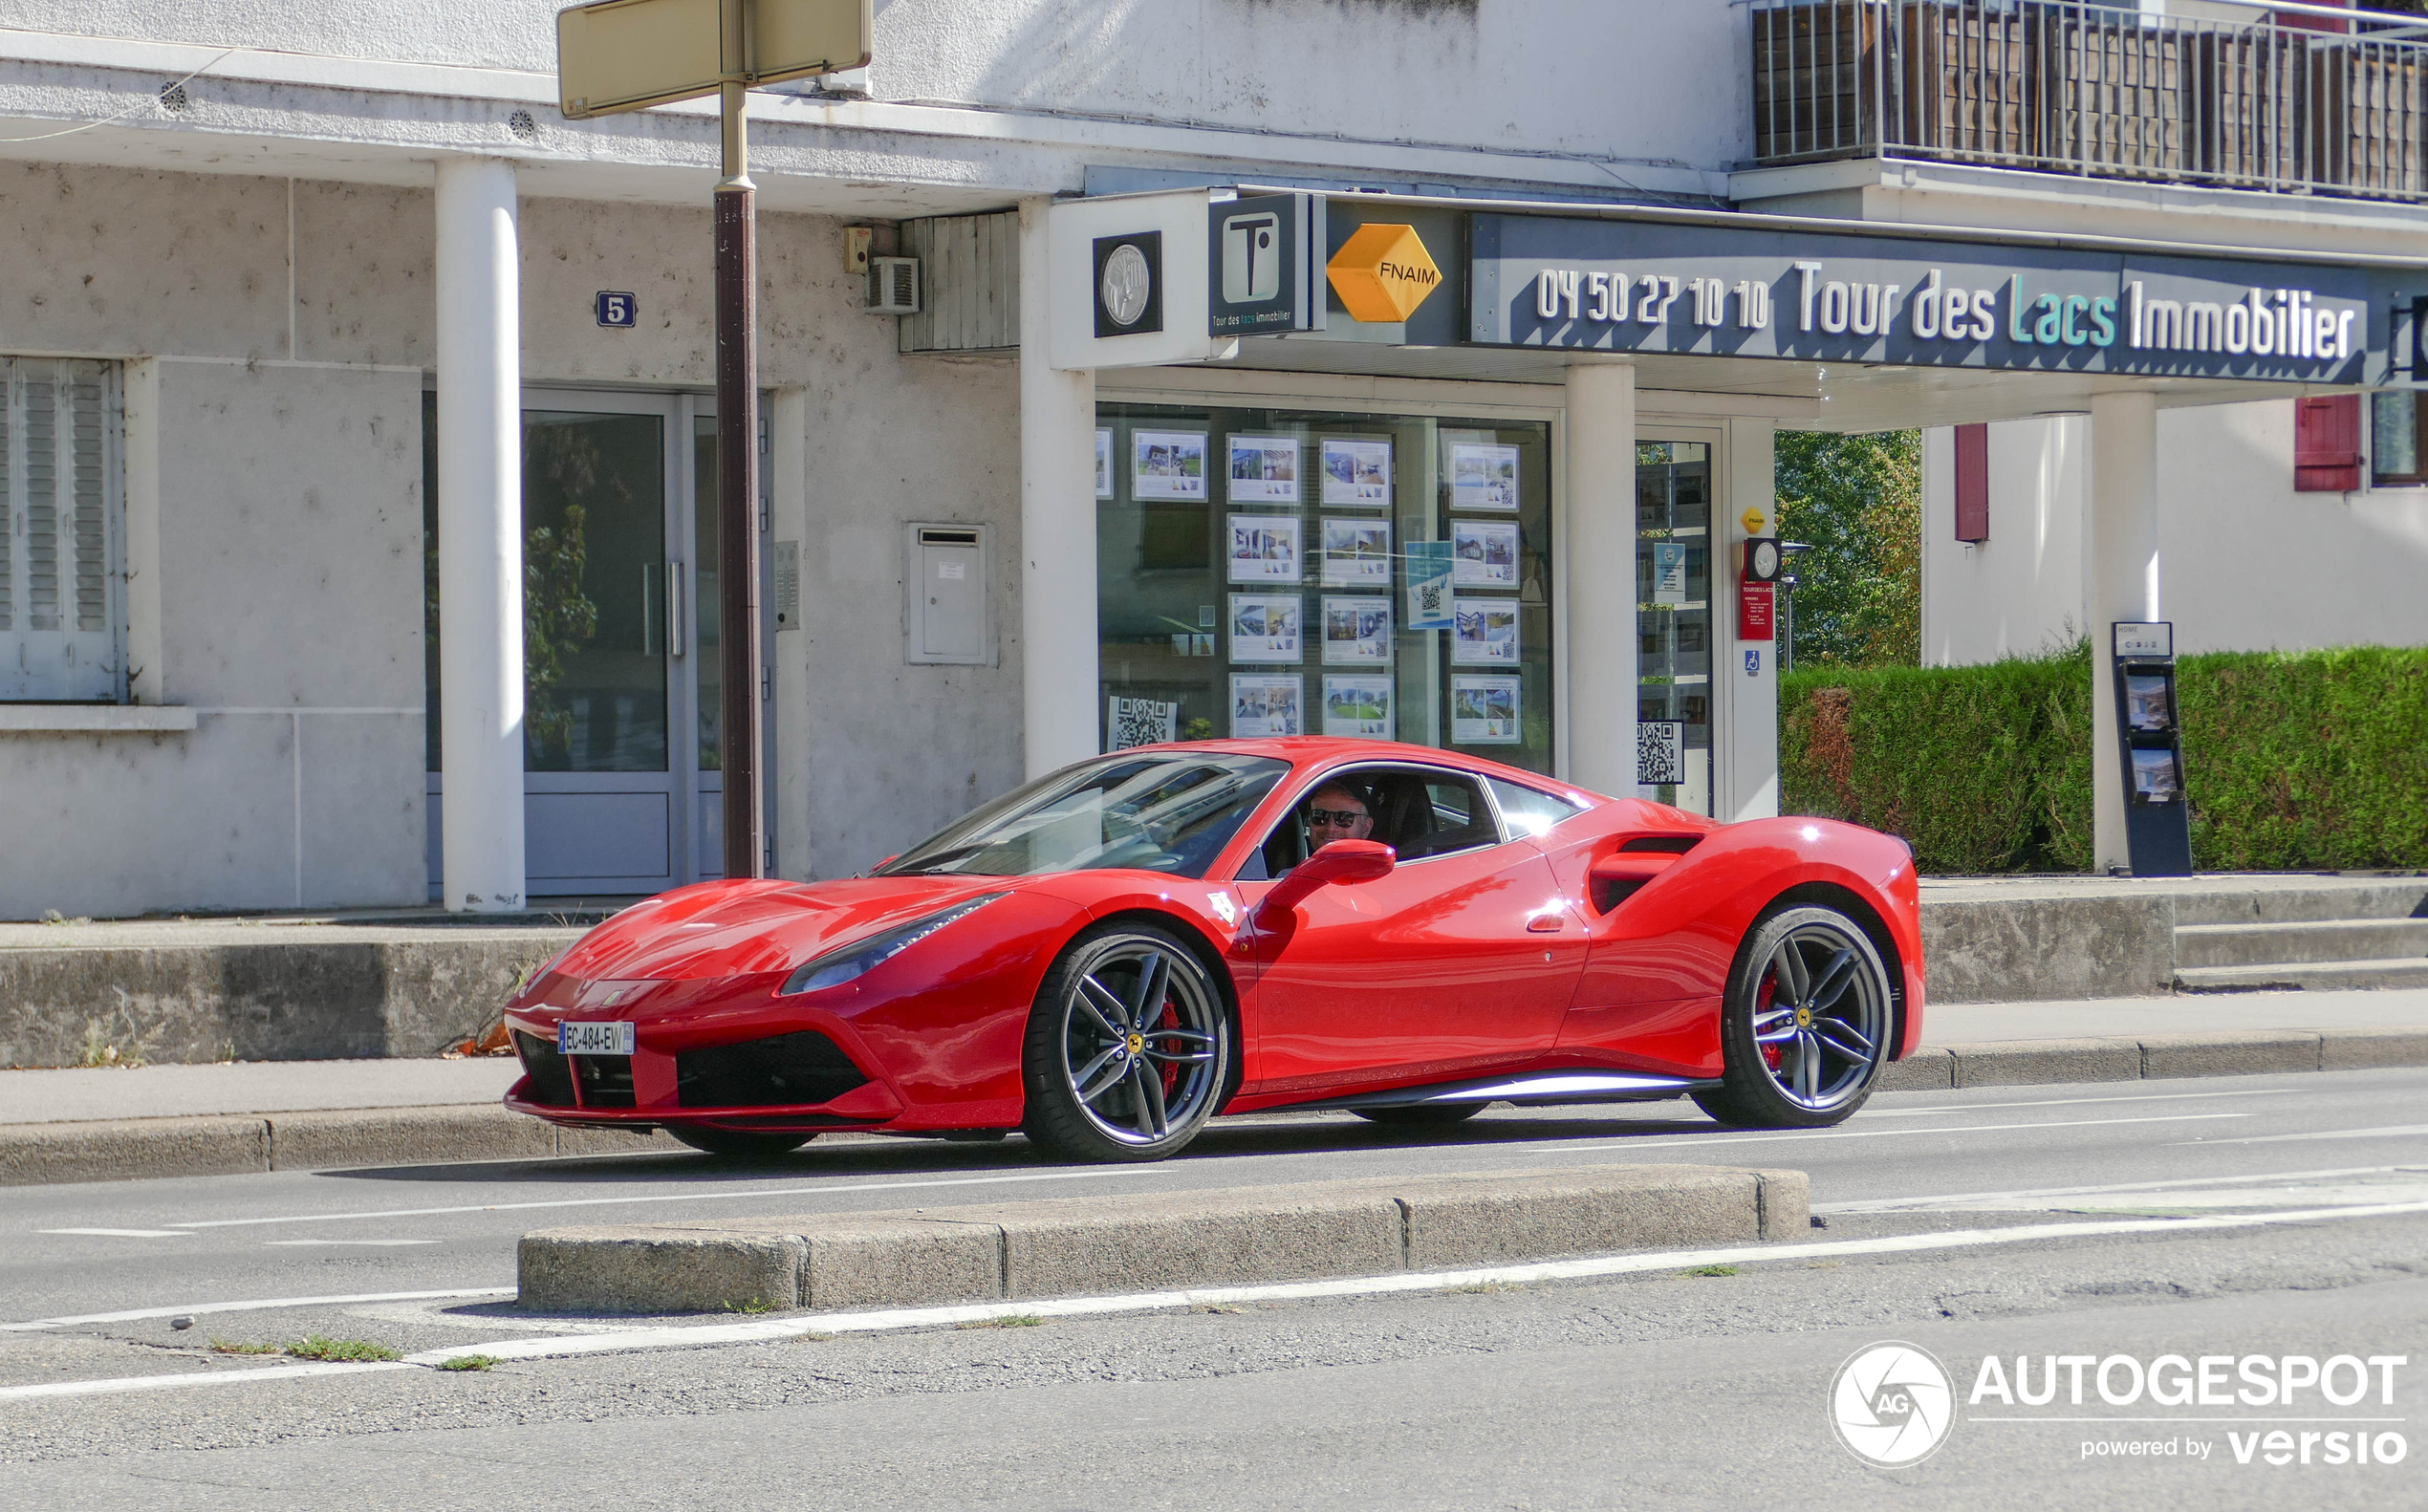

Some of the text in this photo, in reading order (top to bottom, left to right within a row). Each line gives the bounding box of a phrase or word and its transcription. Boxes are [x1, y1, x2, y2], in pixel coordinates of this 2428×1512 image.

[1379, 262, 1436, 285] FNAIM
[607, 296, 625, 323] 5
[1213, 315, 1227, 326] Tour
[1227, 315, 1240, 325] des
[1256, 310, 1290, 323] immobilier
[1537, 260, 2355, 359] 04 50 27 10 10 Tour des Lacs Immobilier
